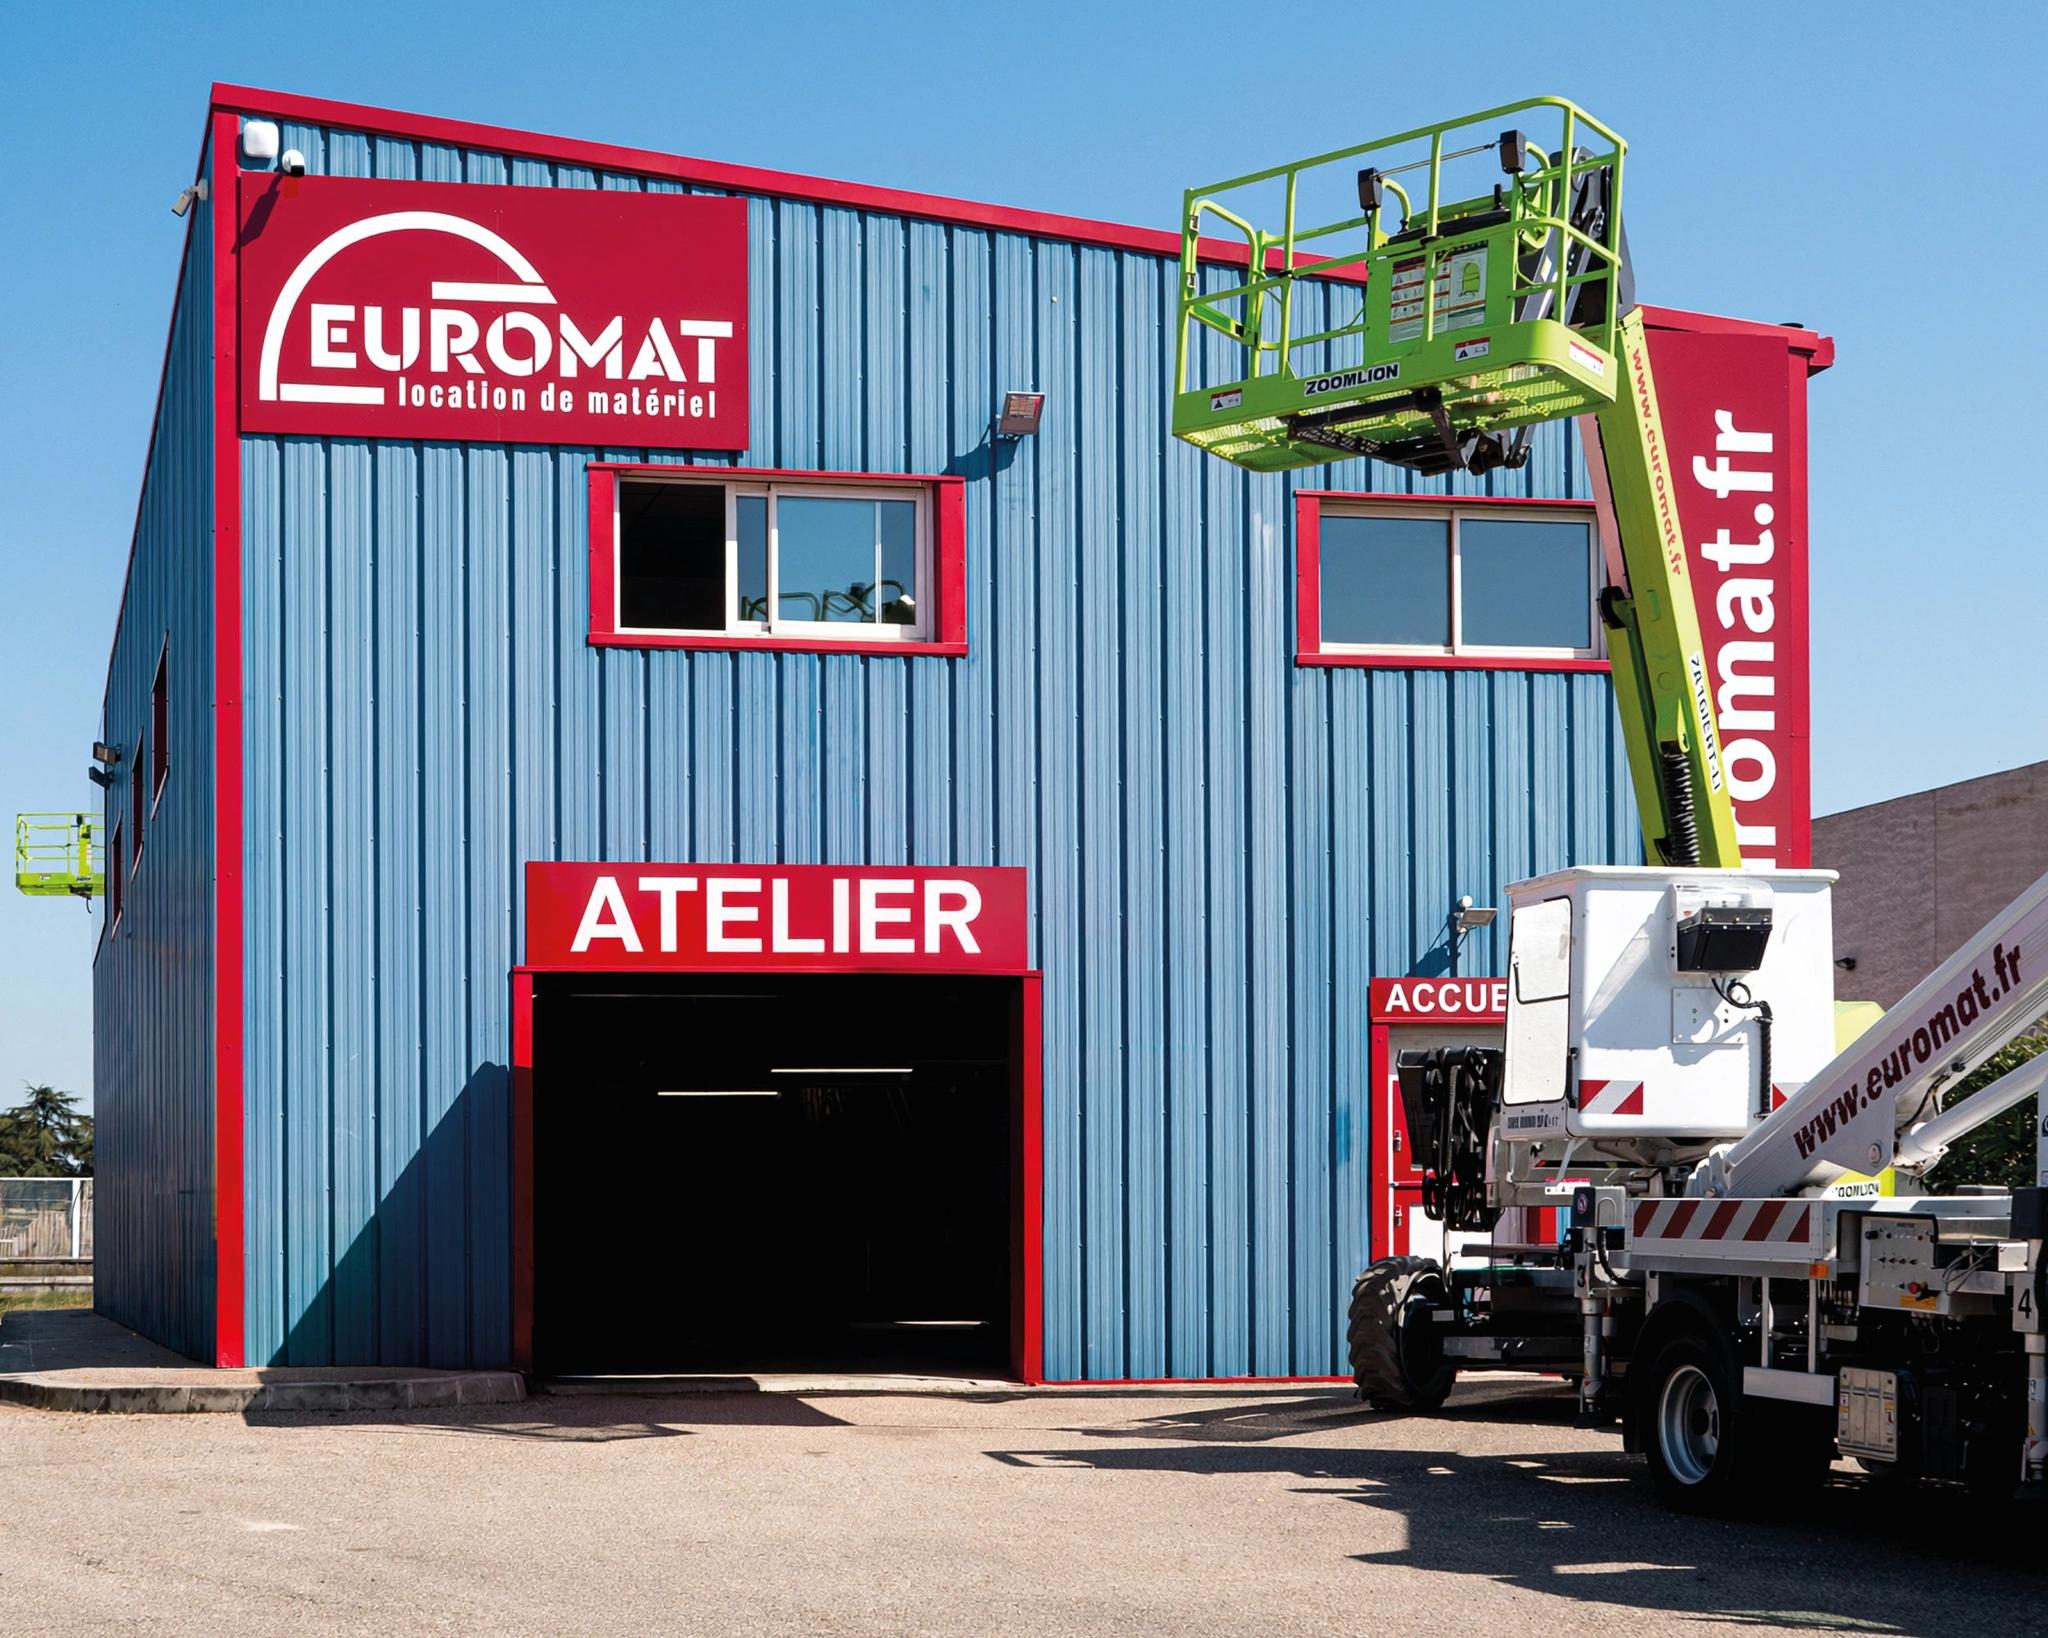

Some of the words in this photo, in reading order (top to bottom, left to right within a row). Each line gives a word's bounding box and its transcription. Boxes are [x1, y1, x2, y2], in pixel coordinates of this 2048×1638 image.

[310, 303, 733, 384] EUROMAT
[399, 376, 526, 411] location
[540, 382, 574, 413] de
[588, 386, 717, 419] matériel
[1305, 363, 1399, 396] ZOOMLION
[569, 875, 983, 955] ATELIER
[1792, 942, 2022, 1160] www.euromat.fr
[2018, 1288, 2033, 1319] 4
